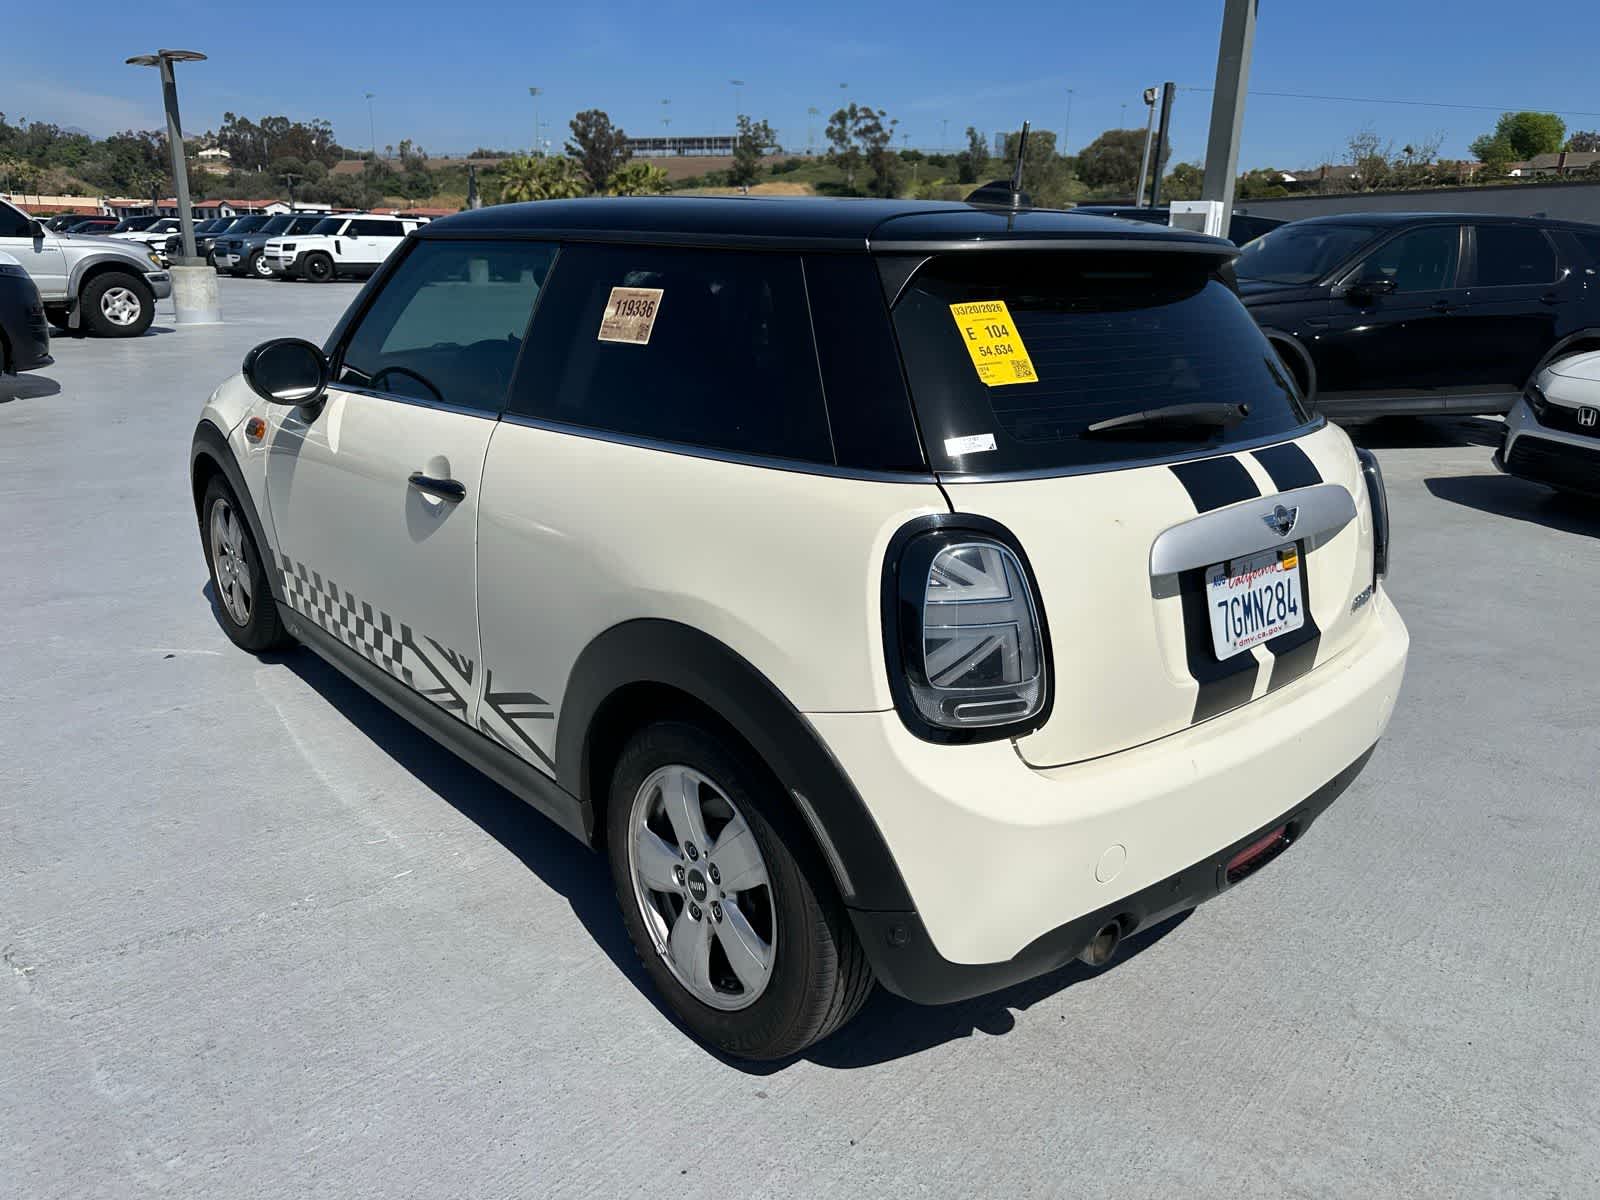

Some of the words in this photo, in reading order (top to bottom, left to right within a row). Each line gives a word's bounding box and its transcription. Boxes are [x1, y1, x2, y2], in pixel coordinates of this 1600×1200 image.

[615, 299, 655, 318] 119336
[953, 303, 1003, 316] 03/20/2026
[966, 327, 977, 340] E
[985, 324, 1009, 338] 104
[1218, 577, 1298, 643] 7GMN284
[1238, 625, 1283, 647] dmv.ca.gov
